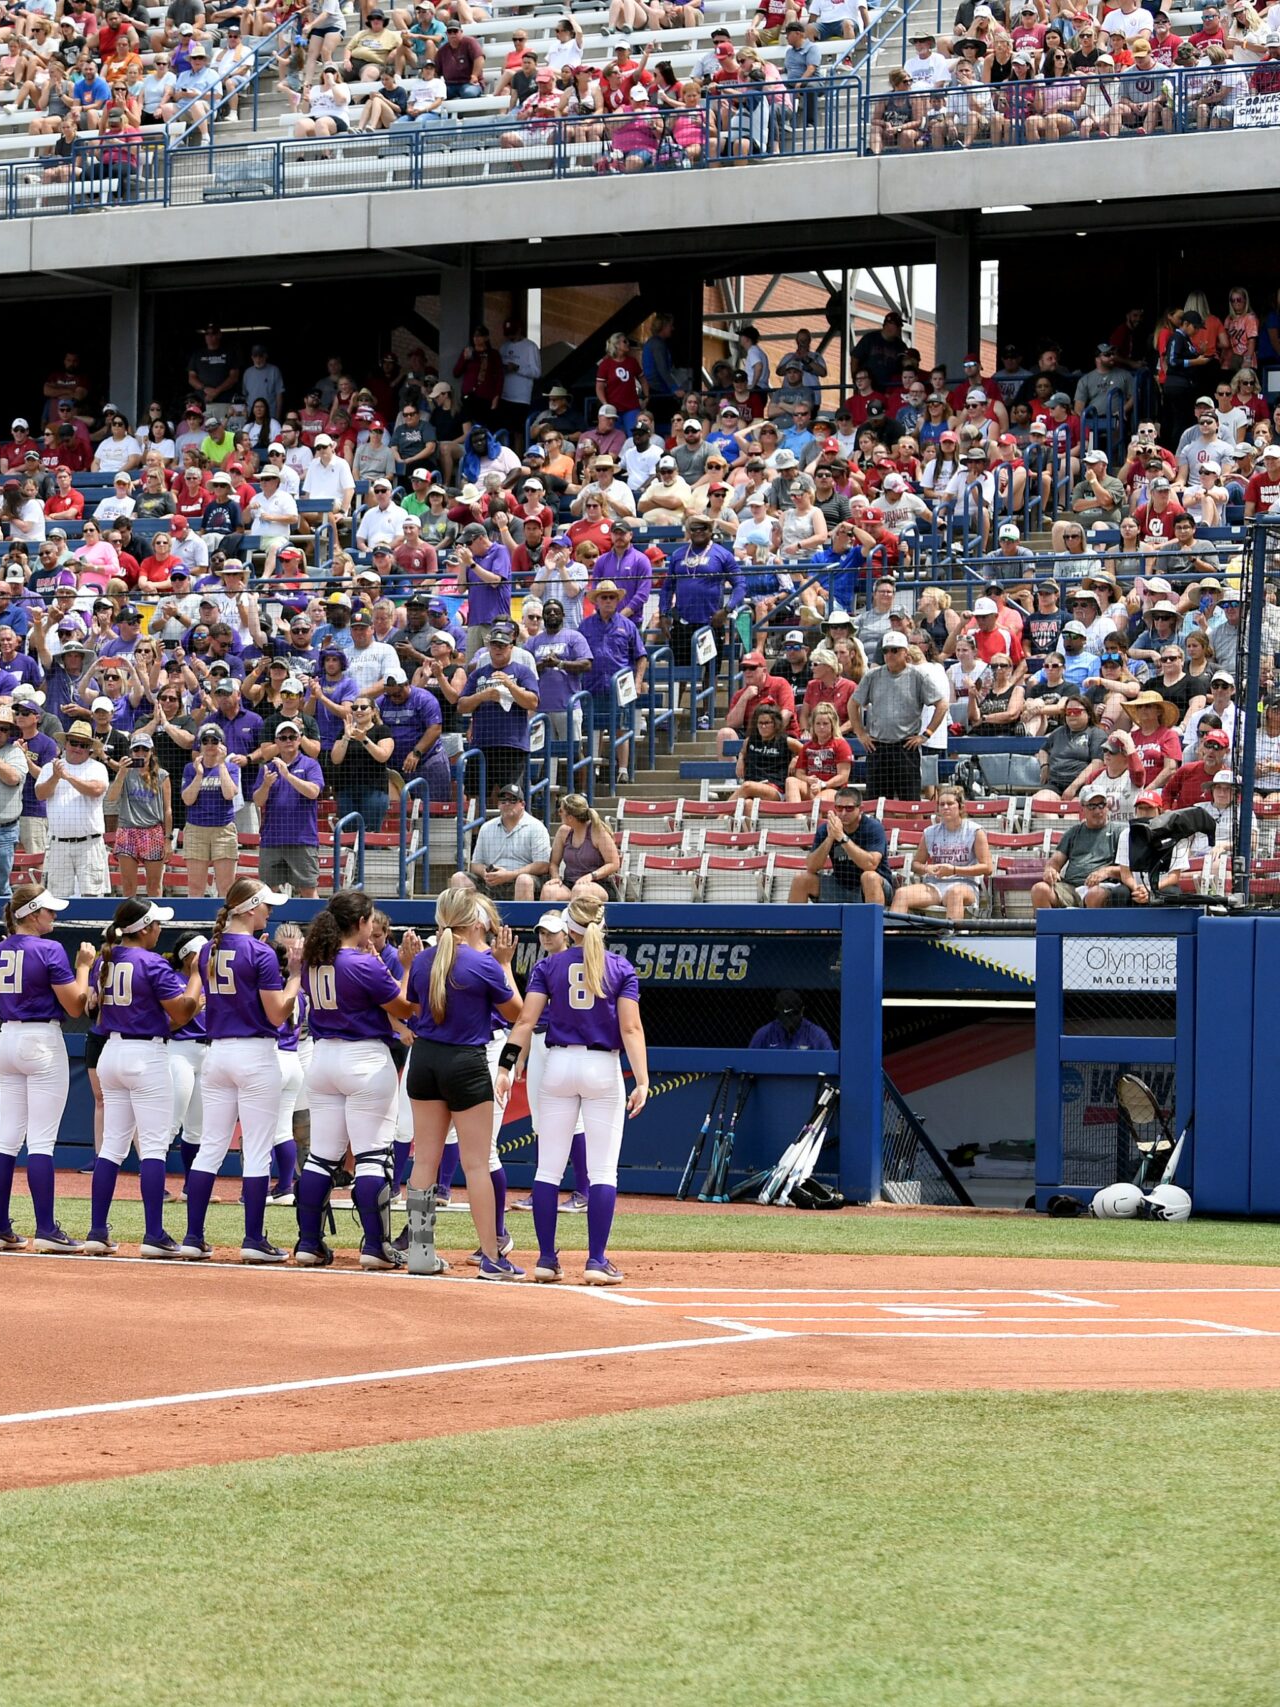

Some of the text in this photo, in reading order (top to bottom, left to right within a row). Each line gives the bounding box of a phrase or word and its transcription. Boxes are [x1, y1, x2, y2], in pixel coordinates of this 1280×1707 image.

[1136, 76, 1155, 95] OU
[615, 367, 629, 381] OU
[1148, 518, 1164, 536] OU
[1030, 621, 1057, 632] USA
[208, 949, 241, 994] 15
[635, 943, 751, 980] SERIES
[98, 961, 133, 1006] 20
[309, 965, 338, 1010] 10
[569, 963, 595, 1010] 8
[1093, 976, 1136, 984] MADE
